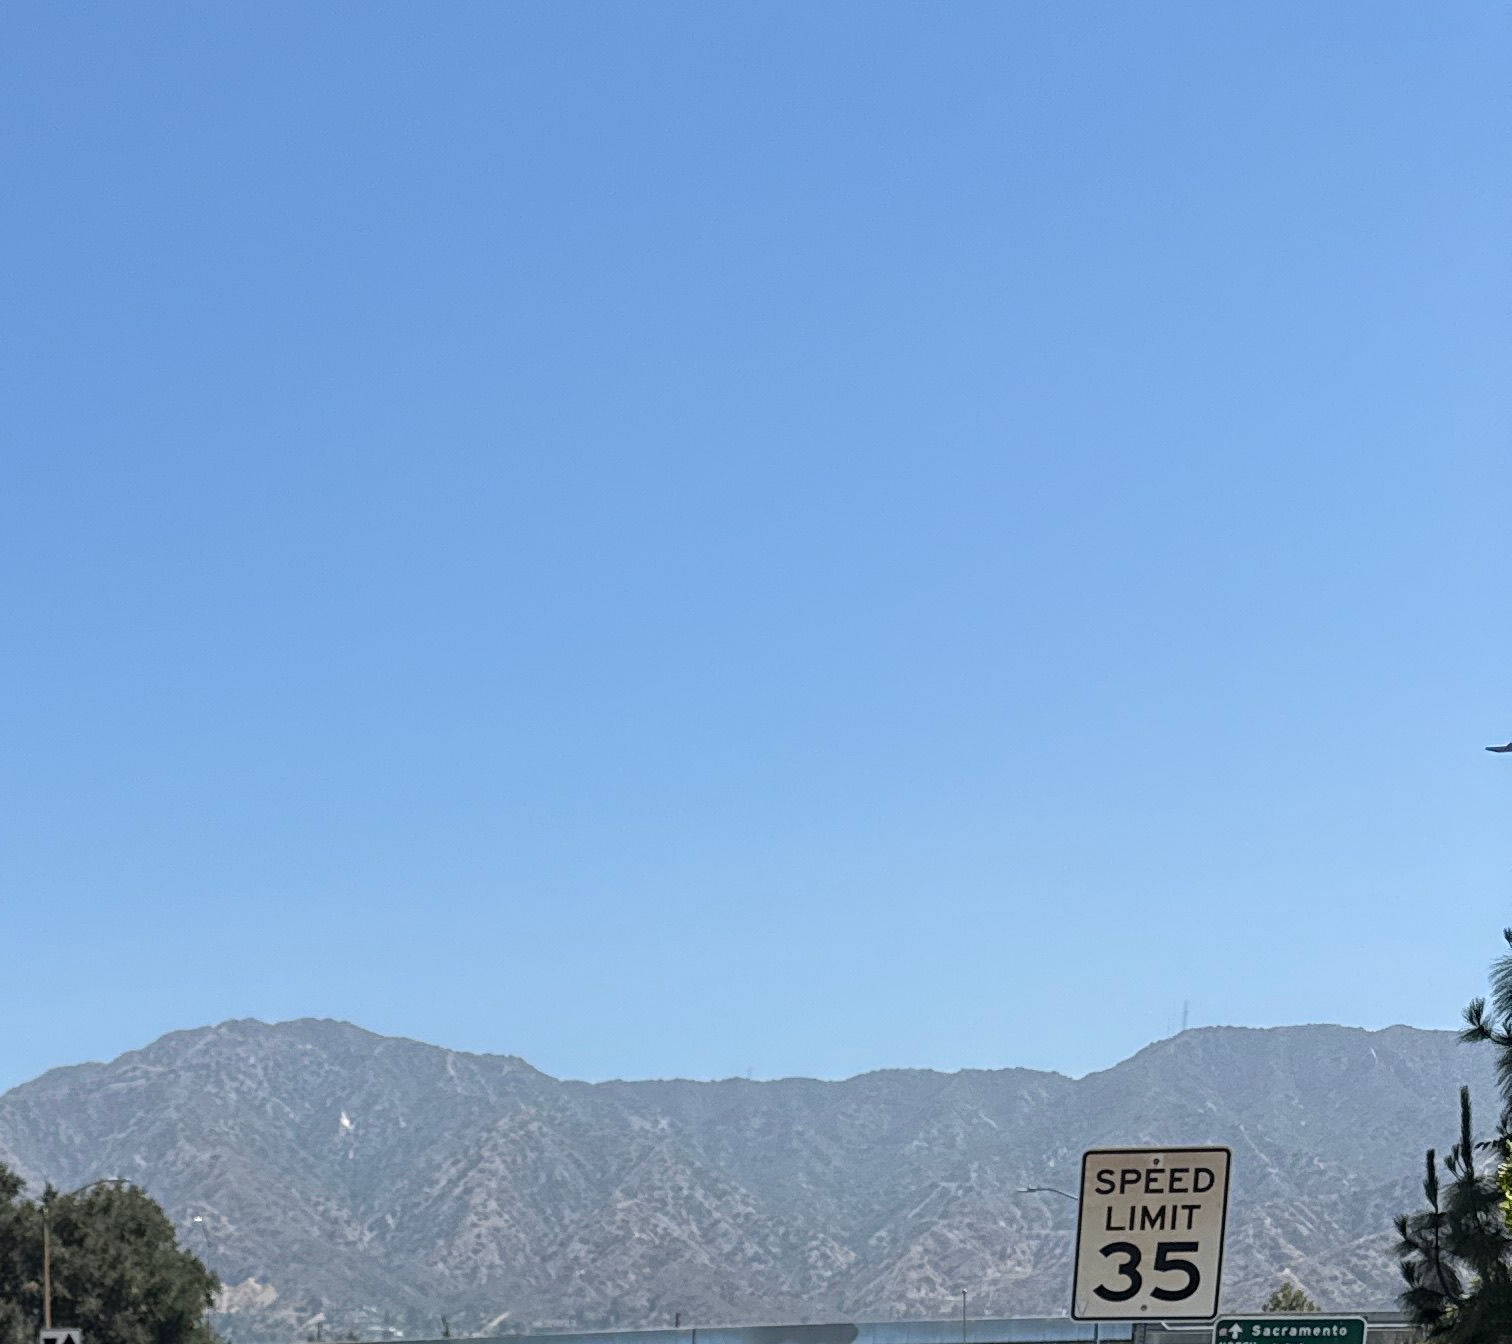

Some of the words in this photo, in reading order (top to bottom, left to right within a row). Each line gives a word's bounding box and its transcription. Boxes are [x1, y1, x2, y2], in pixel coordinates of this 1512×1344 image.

[1094, 1167, 1216, 1195] SPEED
[1104, 1204, 1202, 1232] LIMIT
[1092, 1240, 1201, 1303] 35
[1251, 1324, 1348, 1337] Sacramento
